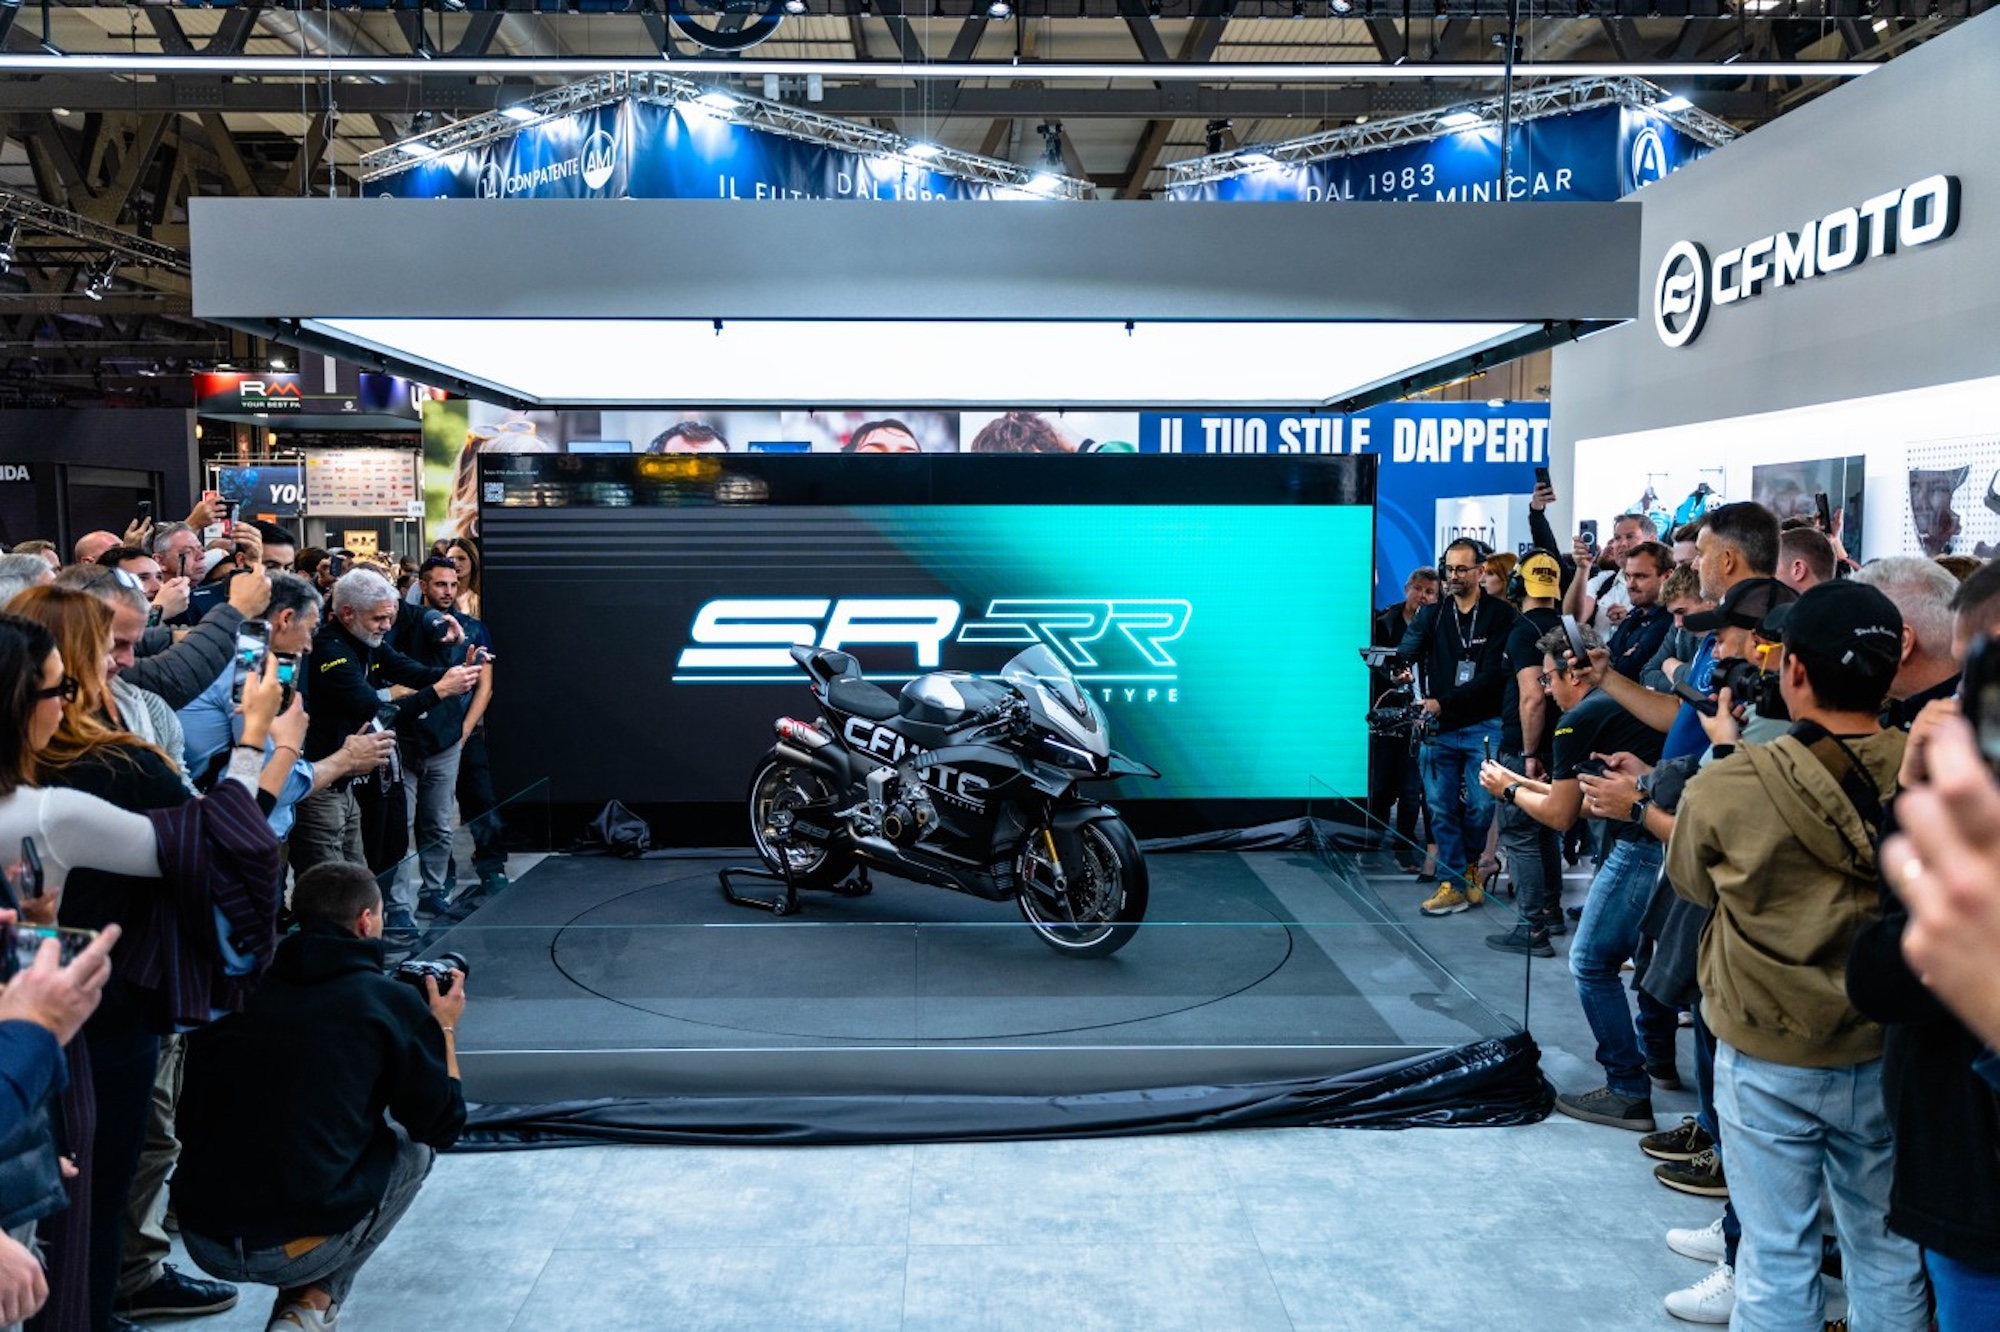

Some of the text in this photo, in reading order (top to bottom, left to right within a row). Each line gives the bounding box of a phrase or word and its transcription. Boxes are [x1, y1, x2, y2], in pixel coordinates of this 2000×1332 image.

[507, 171, 532, 194] CON
[534, 158, 578, 188] PATENTE
[587, 146, 611, 173] AM
[719, 174, 741, 200] IL
[837, 172, 882, 201] DAL
[1307, 163, 1436, 201] DAL 1983
[1436, 168, 1572, 202] MINICAR
[1711, 174, 1955, 306] CFMOTO
[241, 401, 265, 409] YOUR
[267, 401, 288, 409] BEST
[1392, 417, 1550, 463] DAPPERT
[1084, 688, 1178, 702] TYPE
